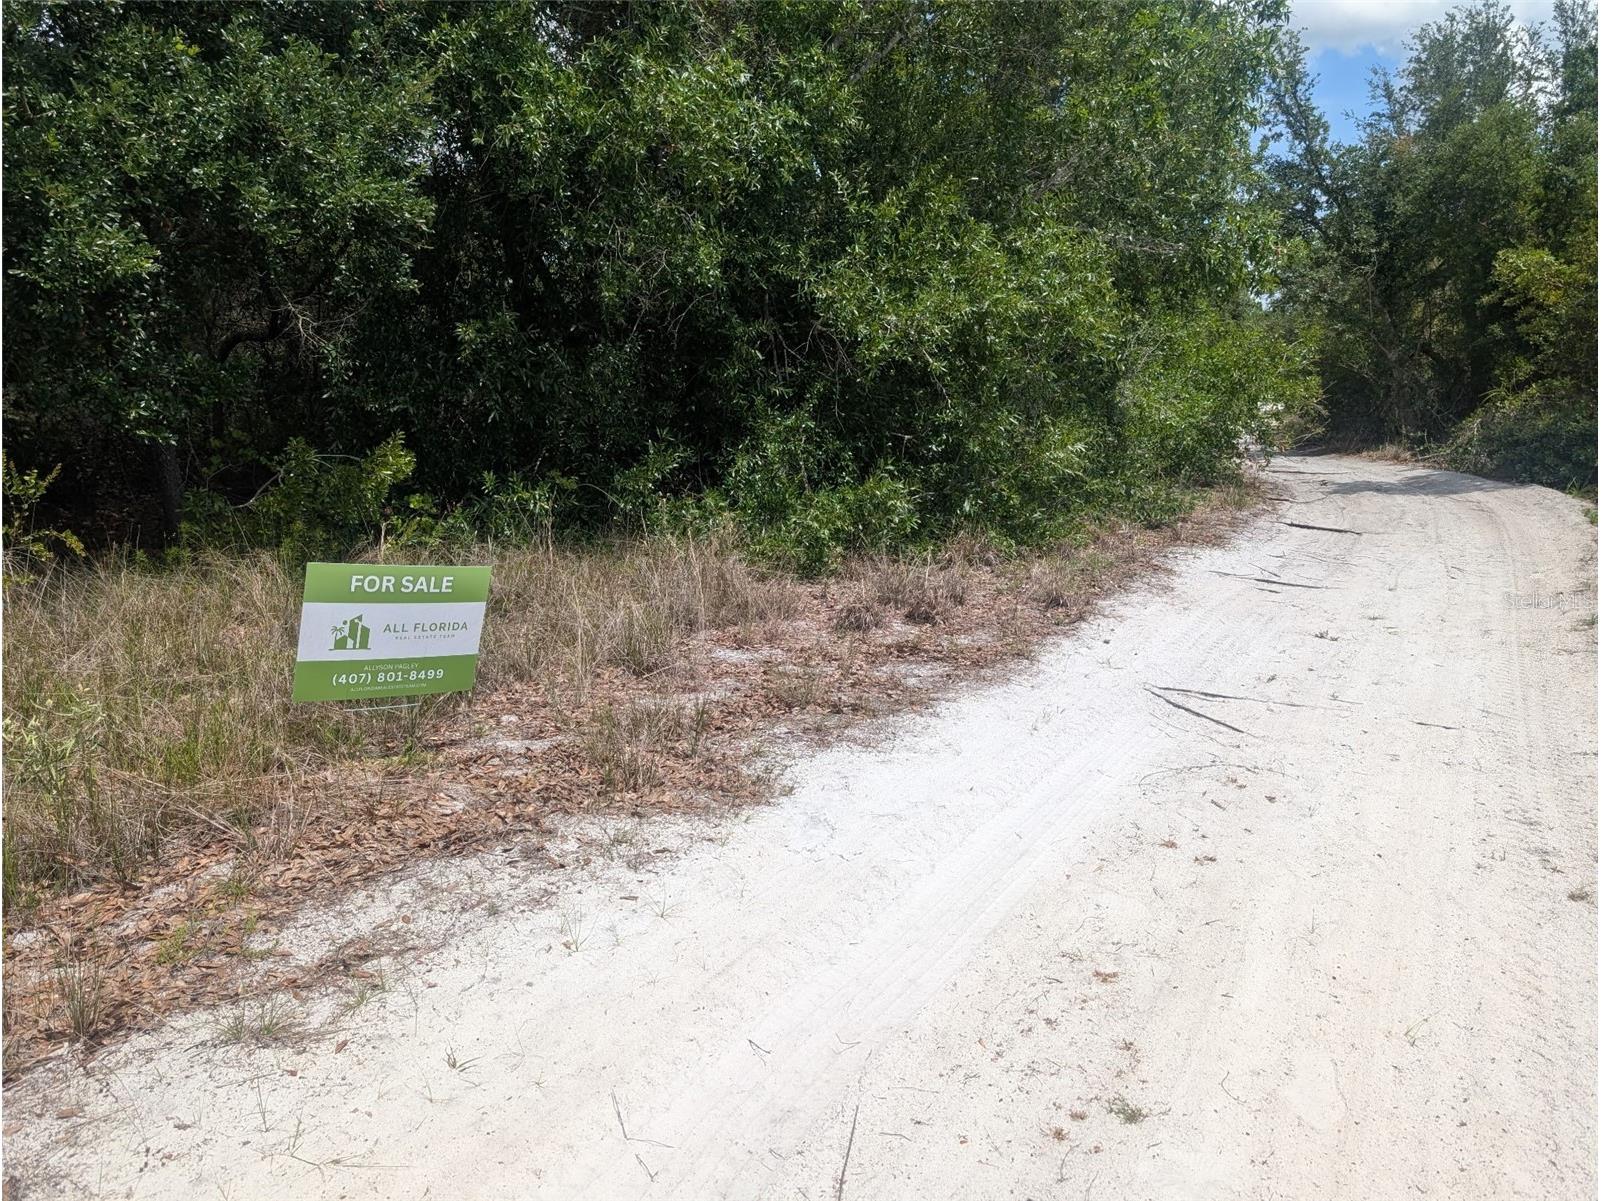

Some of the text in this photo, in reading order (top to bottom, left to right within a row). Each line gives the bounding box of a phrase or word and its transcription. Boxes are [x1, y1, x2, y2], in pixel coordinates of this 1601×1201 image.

[351, 575, 453, 593] FOR SALE
[383, 622, 468, 633] ALL FLORIDA
[332, 668, 444, 686] (407) 801-8499
